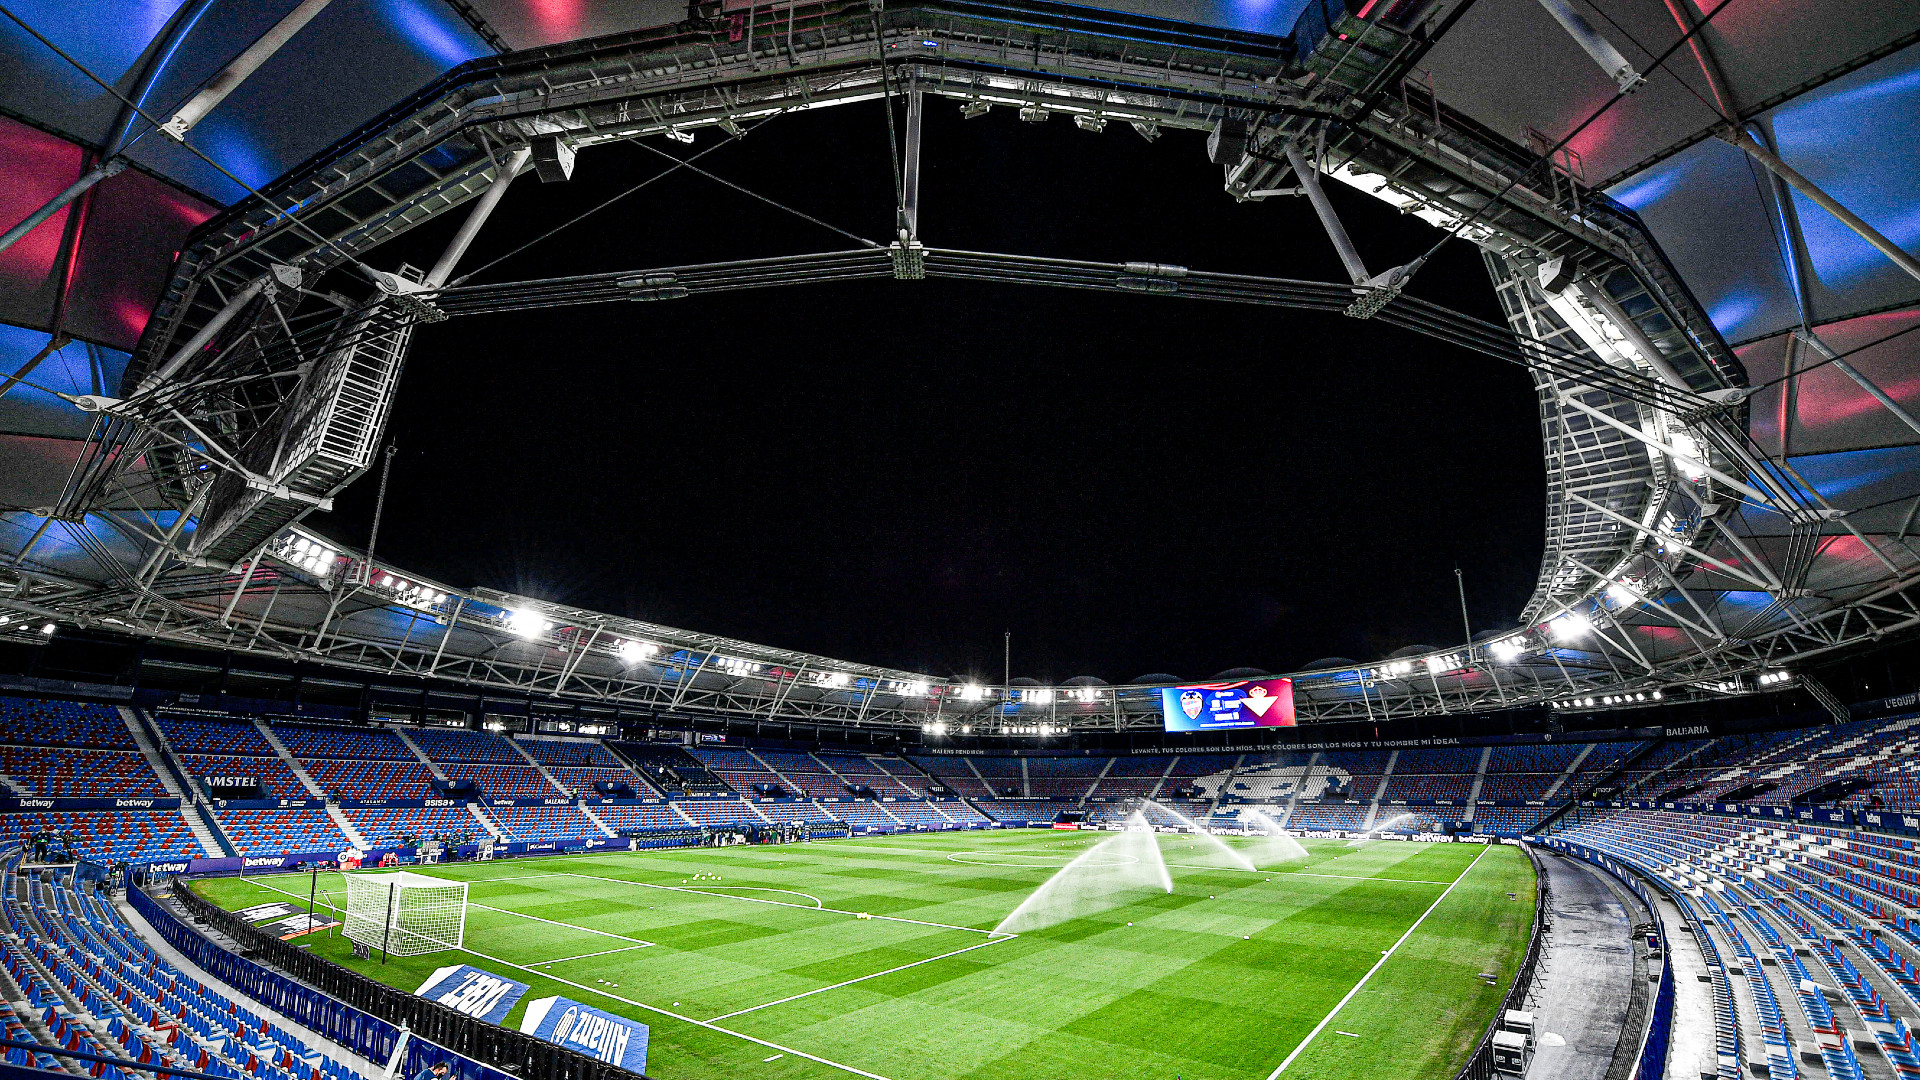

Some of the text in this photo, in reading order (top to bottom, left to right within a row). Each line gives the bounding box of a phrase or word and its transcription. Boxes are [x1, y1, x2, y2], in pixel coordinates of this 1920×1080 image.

[1383, 739, 1419, 747] NOMBRE
[204, 776, 257, 787] AMSTEL
[20, 799, 54, 808] betway
[116, 799, 153, 808] betway
[1412, 834, 1454, 843] betway
[1458, 835, 1489, 844] betway
[245, 857, 286, 867] betway
[150, 862, 188, 873] betway
[569, 1011, 632, 1068] Allianz
